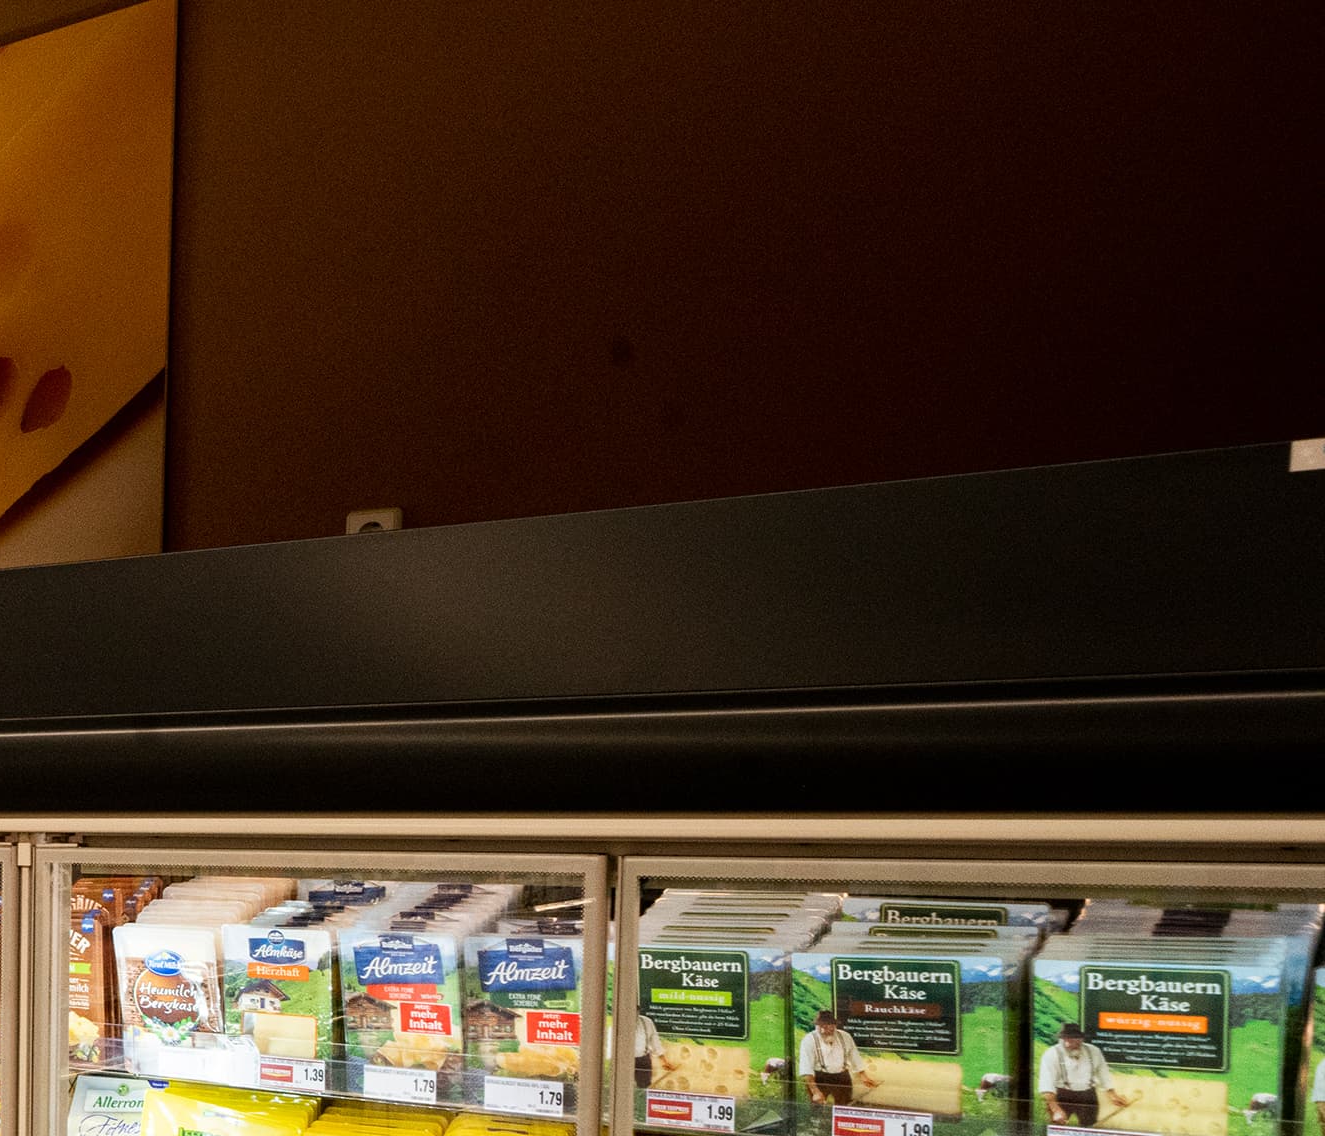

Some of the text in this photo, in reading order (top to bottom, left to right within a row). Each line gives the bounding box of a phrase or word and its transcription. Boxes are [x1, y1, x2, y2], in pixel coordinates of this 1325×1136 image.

[253, 944, 303, 960] Almkäse
[256, 966, 300, 978] Herzhaft
[360, 956, 437, 979] Almzeit
[641, 954, 742, 974] Bergbauern
[484, 959, 569, 986] Almzeit
[681, 972, 719, 988] Käse
[837, 964, 953, 985] Bergbauern
[1087, 973, 1222, 996] Bergbauern
[884, 985, 926, 1001] Käse
[865, 1004, 926, 1016] Rauchkäse
[1141, 995, 1190, 1013] Käse
[410, 1011, 437, 1020] mehr
[409, 1020, 442, 1030] Inhalt
[538, 1020, 567, 1029] mehr
[536, 1030, 572, 1041] Inhalt
[539, 1092, 562, 1106] 1.79
[706, 1105, 733, 1121] 1.99
